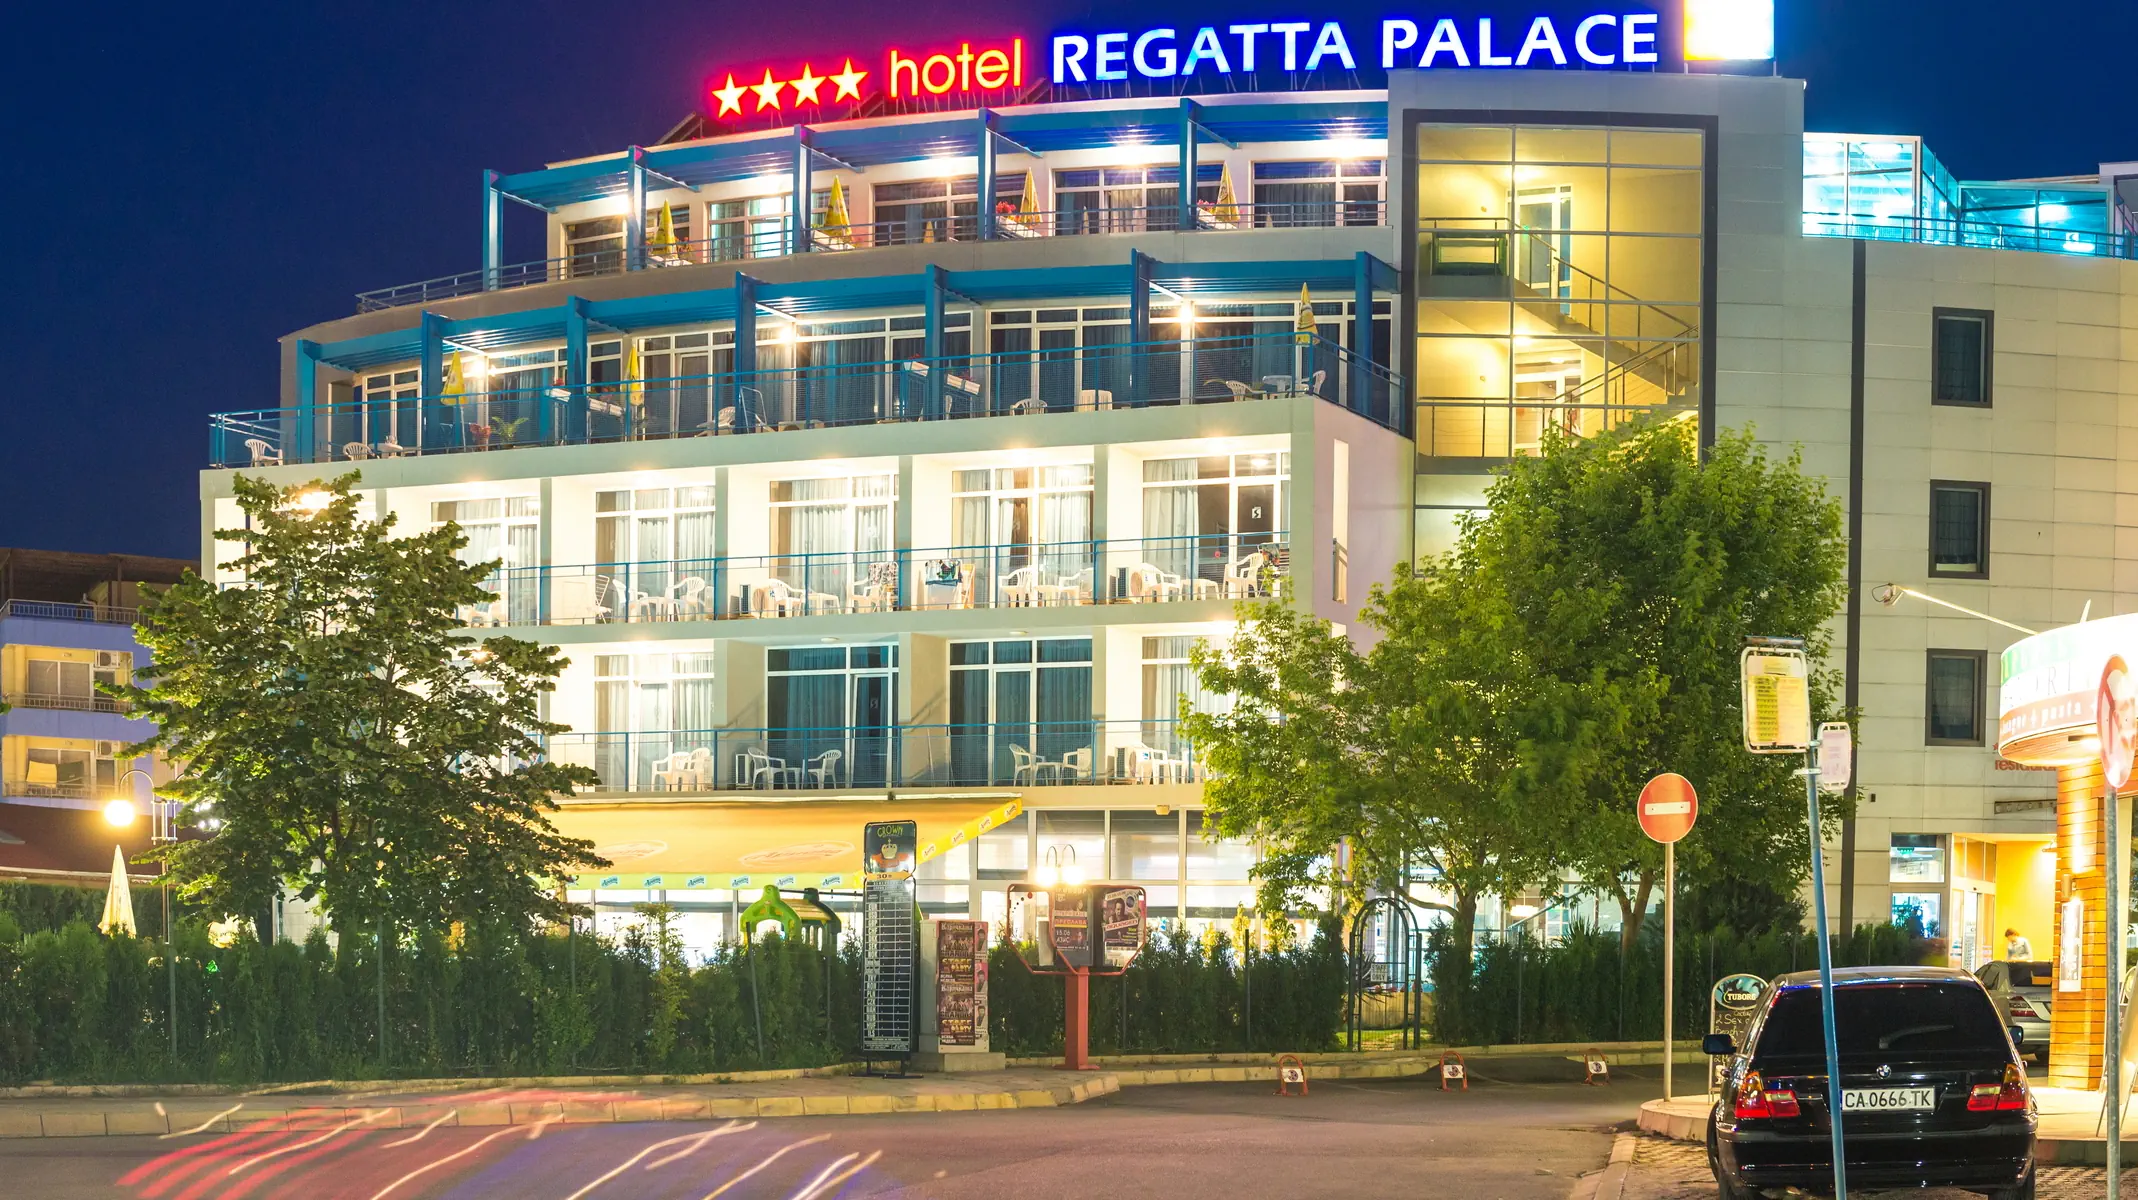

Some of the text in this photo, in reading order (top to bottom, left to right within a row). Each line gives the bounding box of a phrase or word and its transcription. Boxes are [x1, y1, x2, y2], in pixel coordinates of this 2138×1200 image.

[890, 13, 1658, 98] hotel REGATTA PALACE
[2041, 700, 2081, 727] pasta
[1727, 993, 1757, 1001] TUBORG
[1845, 1090, 1931, 1108] CA 0666 TK
